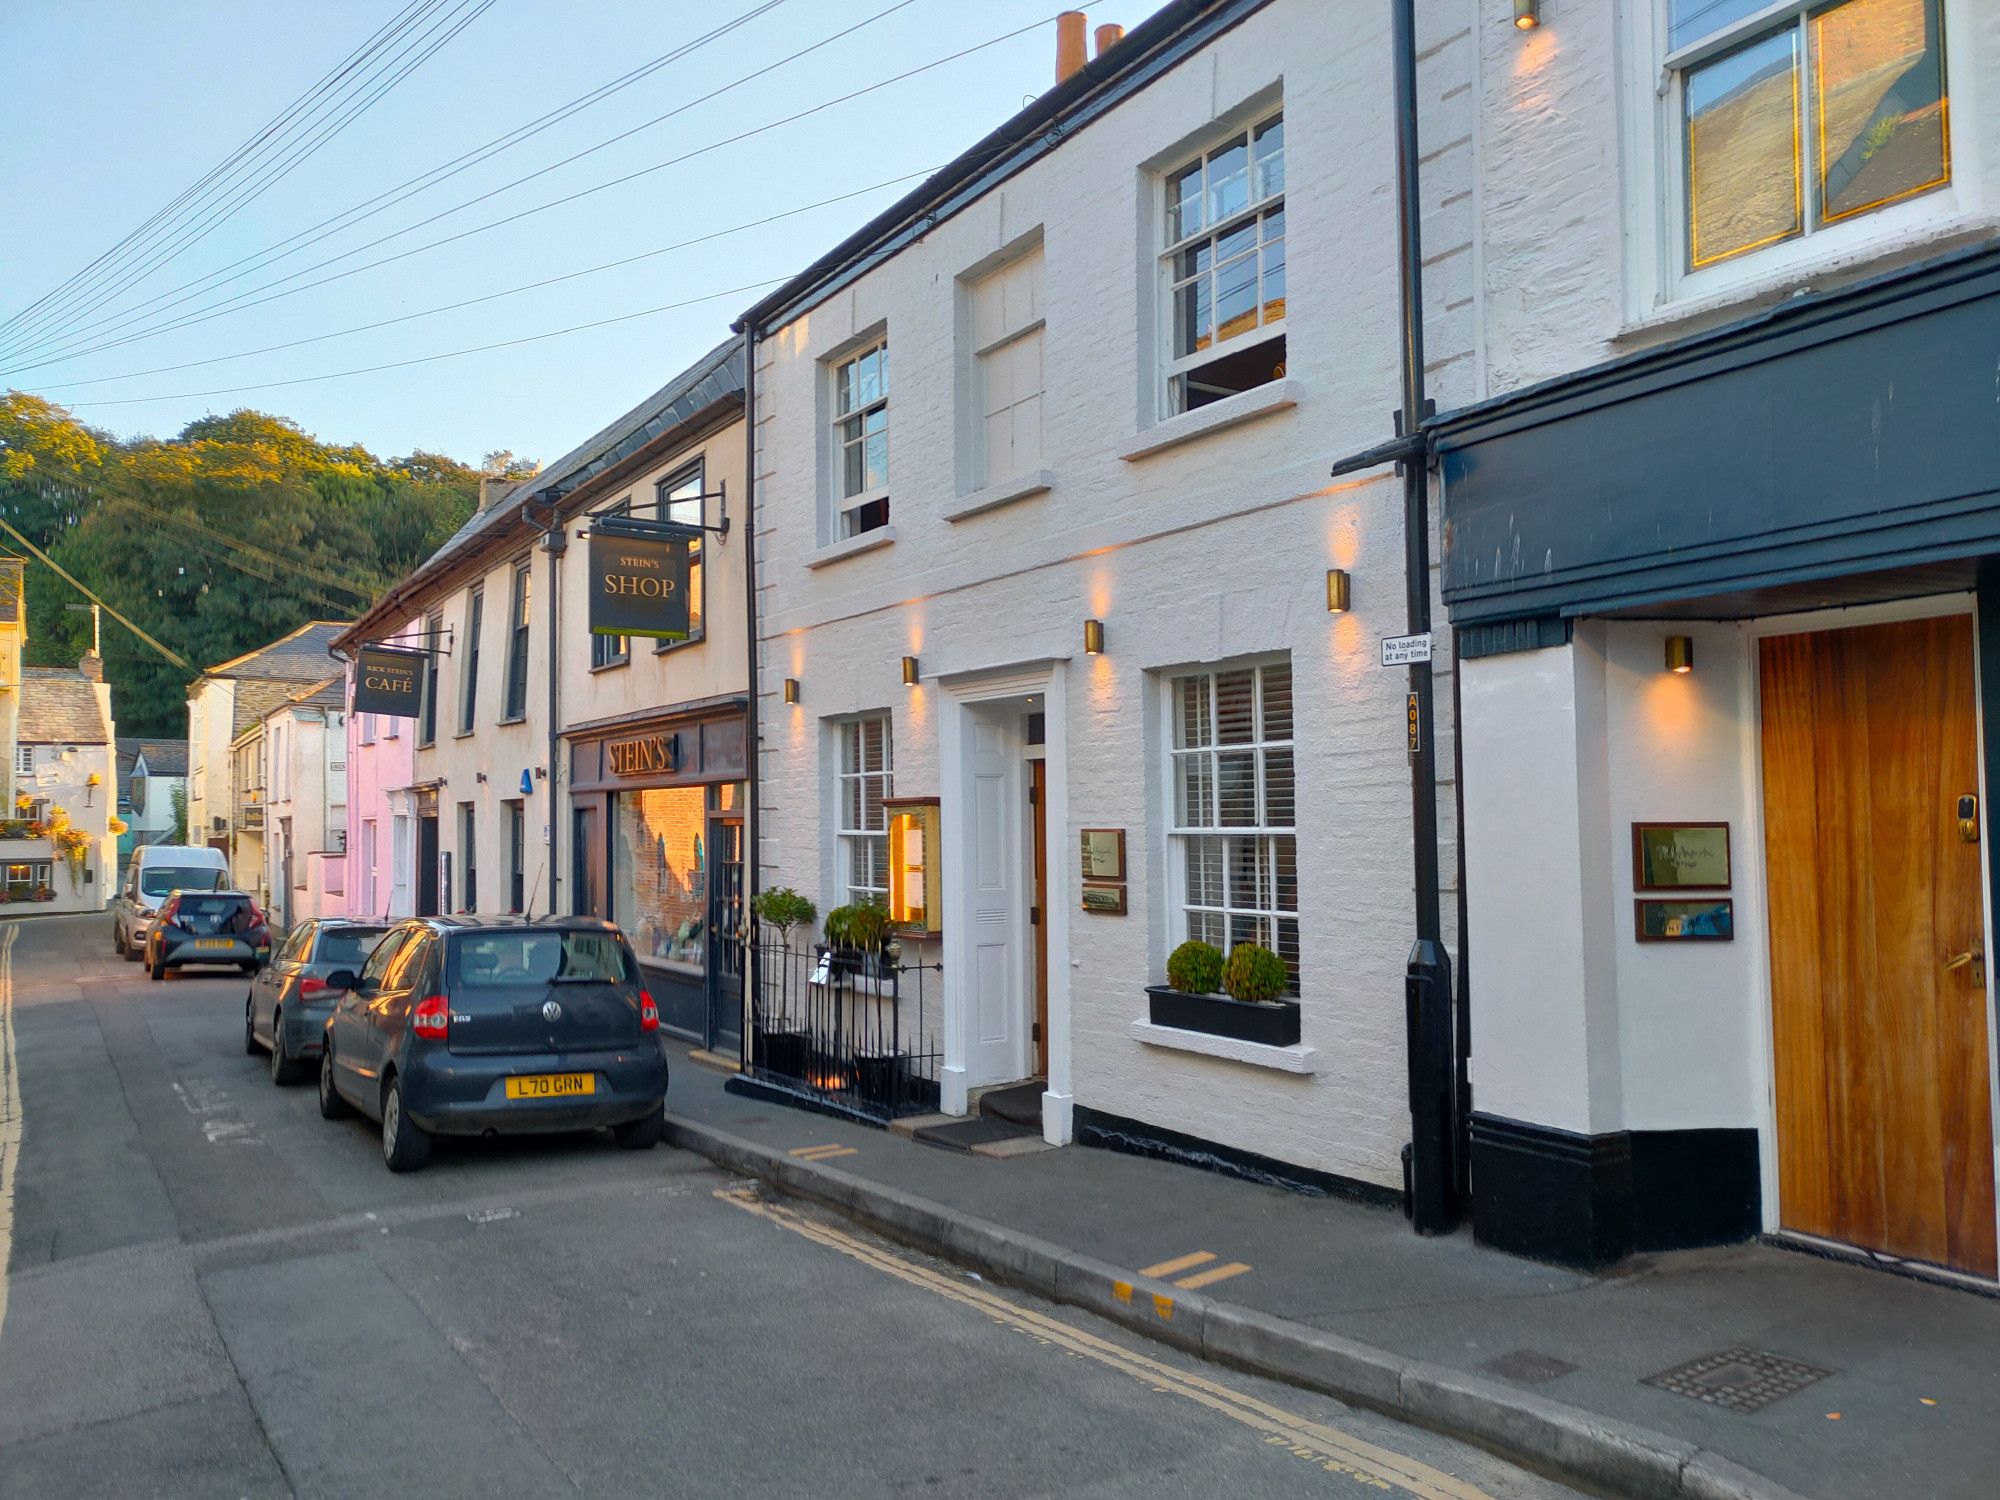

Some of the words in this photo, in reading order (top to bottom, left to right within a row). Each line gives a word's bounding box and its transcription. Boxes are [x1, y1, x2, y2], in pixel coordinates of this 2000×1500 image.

[620, 557, 660, 569] STEIN'S
[604, 574, 675, 598] SHOP
[1385, 642, 1397, 651] No
[1398, 639, 1427, 650] loading
[1385, 653, 1393, 661] at
[1395, 652, 1408, 661] any
[1410, 649, 1428, 659] time
[364, 676, 413, 693] CAFÉ
[1408, 694, 1417, 749] A087
[608, 736, 667, 774] STEIN'S
[518, 1079, 549, 1096] L70
[554, 1075, 583, 1093] GRN
